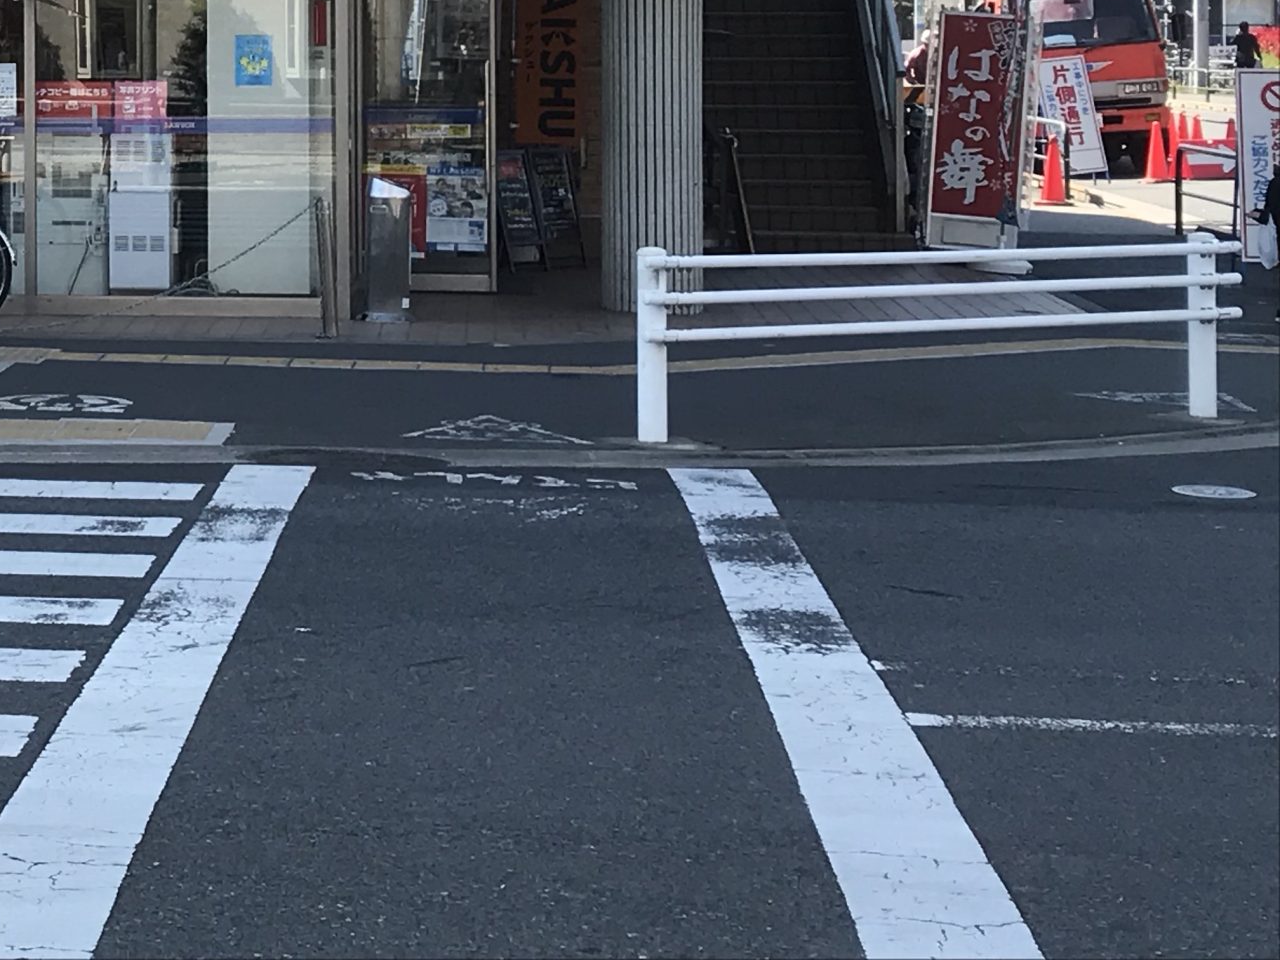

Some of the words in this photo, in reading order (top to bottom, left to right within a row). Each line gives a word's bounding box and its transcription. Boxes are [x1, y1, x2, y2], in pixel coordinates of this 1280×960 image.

[935, 44, 995, 206] はなの舞
[1052, 64, 1086, 146] 片側通行
